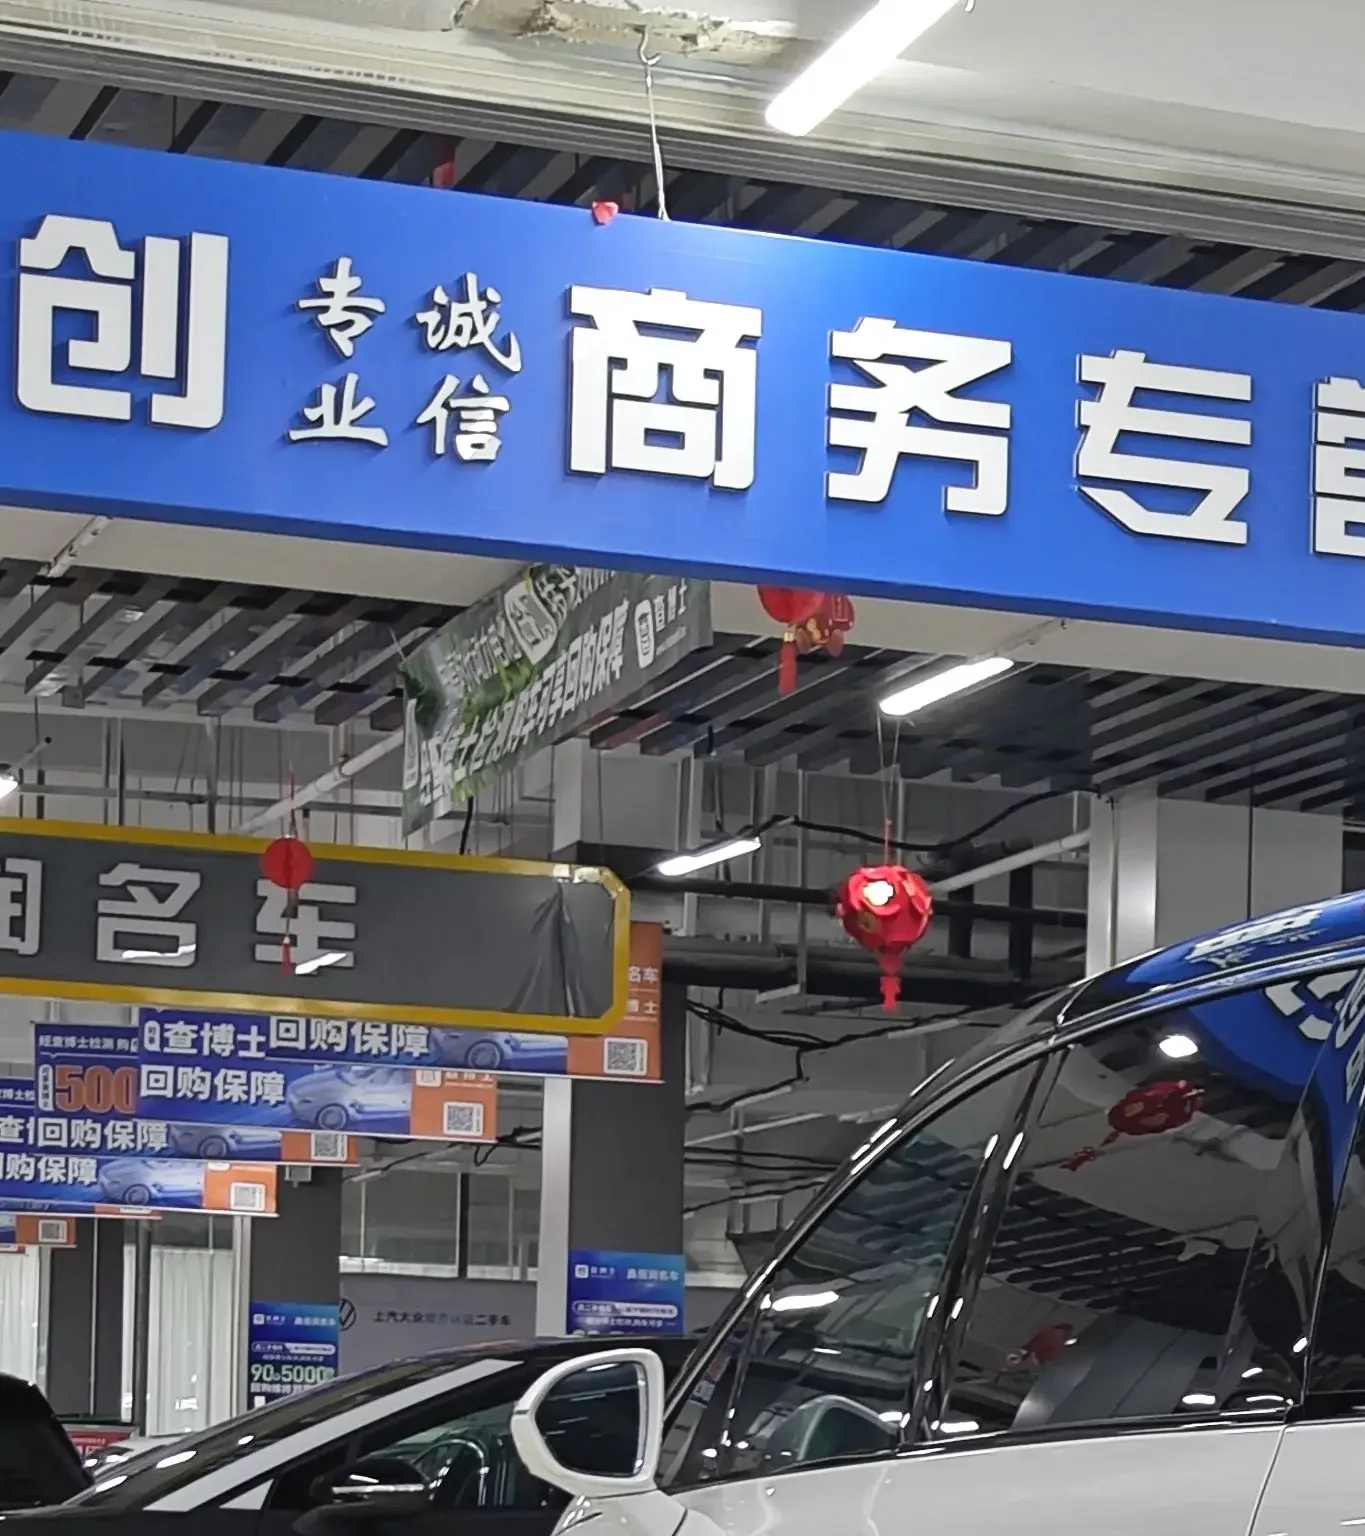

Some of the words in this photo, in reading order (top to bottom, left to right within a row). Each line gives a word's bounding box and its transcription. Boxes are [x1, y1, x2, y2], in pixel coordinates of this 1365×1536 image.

[17, 214, 229, 430] 创
[270, 1016, 430, 1058] 回购保障
[140, 1064, 286, 1108] 回购保障
[37, 1117, 169, 1152] 回购保障
[0, 1154, 98, 1186] 购保障
